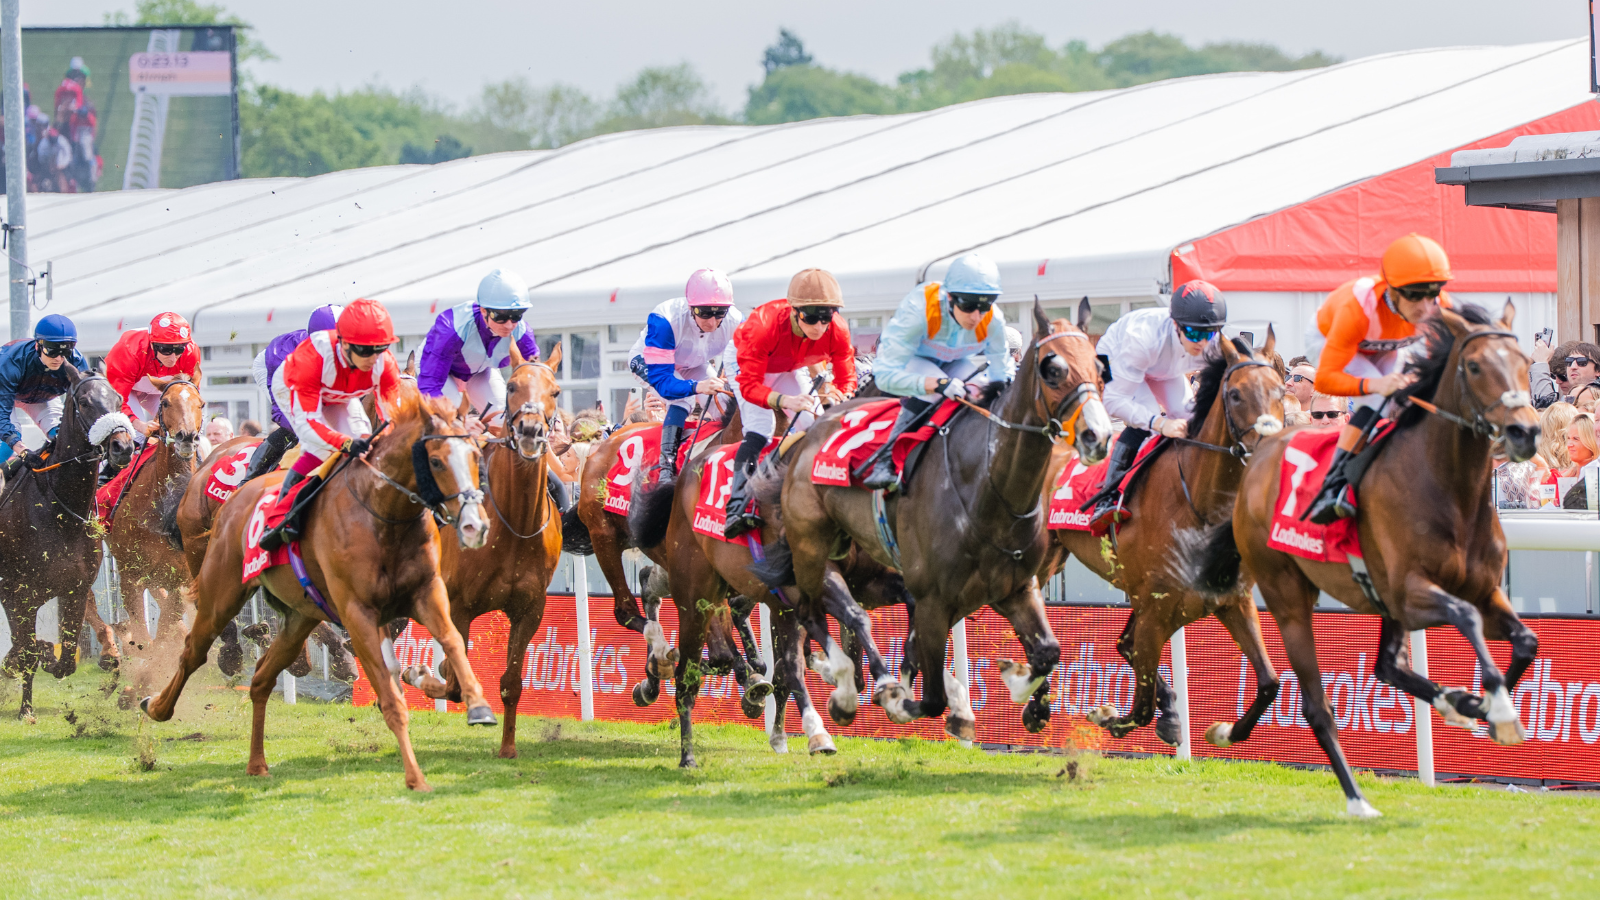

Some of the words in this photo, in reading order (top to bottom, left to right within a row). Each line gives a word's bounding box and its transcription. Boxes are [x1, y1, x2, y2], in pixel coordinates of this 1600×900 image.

[214, 446, 258, 487] 3
[612, 435, 644, 486] 9
[813, 460, 848, 482] Ladbrokes
[1281, 446, 1319, 517] 7
[248, 494, 277, 549] 6
[1049, 508, 1091, 526] Labrokes
[1271, 522, 1324, 554] Ladbrokes
[521, 626, 630, 694] adbrokes
